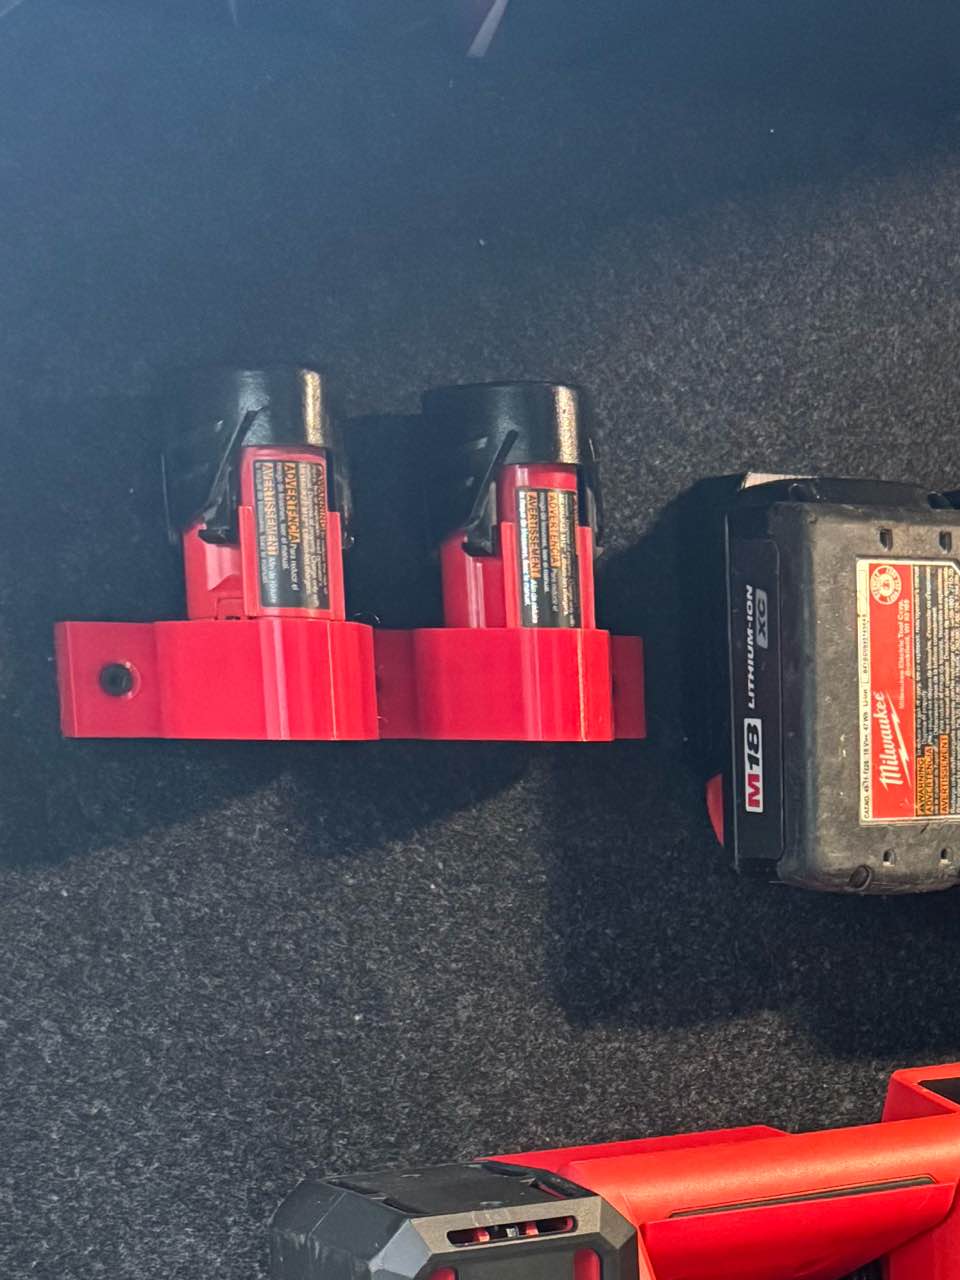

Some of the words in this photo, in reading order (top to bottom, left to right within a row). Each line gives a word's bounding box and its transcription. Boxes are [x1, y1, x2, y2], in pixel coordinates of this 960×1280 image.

[263, 464, 278, 556] AVERTISSEMENT
[285, 465, 299, 543] ADVERTENCIA
[528, 495, 540, 576] AVERTISSEMENT
[548, 494, 559, 567] ADVERTENCIA
[746, 584, 755, 709] LITHIUM-ION
[757, 597, 766, 639] XC
[745, 722, 760, 808] M18
[873, 691, 903, 791] Milwaukee
[918, 758, 926, 802] WARNING
